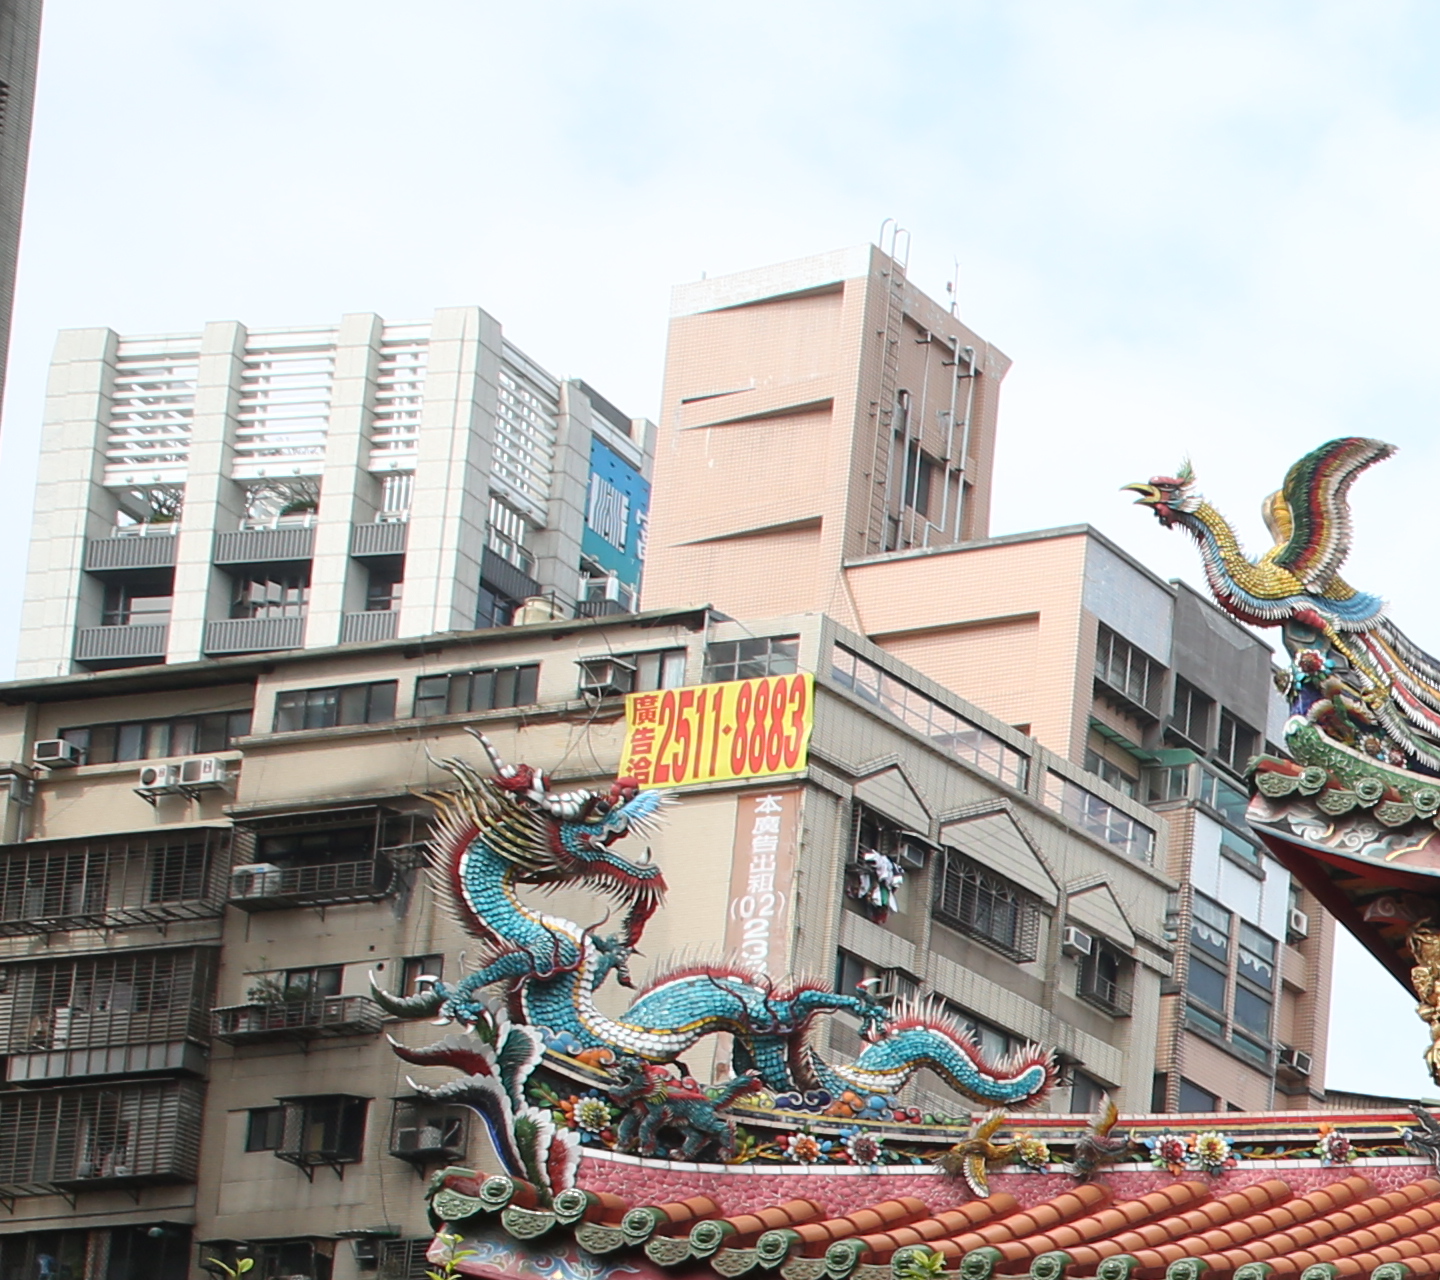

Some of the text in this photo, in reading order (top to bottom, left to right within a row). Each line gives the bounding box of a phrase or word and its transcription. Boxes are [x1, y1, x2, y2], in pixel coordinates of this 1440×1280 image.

[747, 794, 783, 893] 本廣告出租
